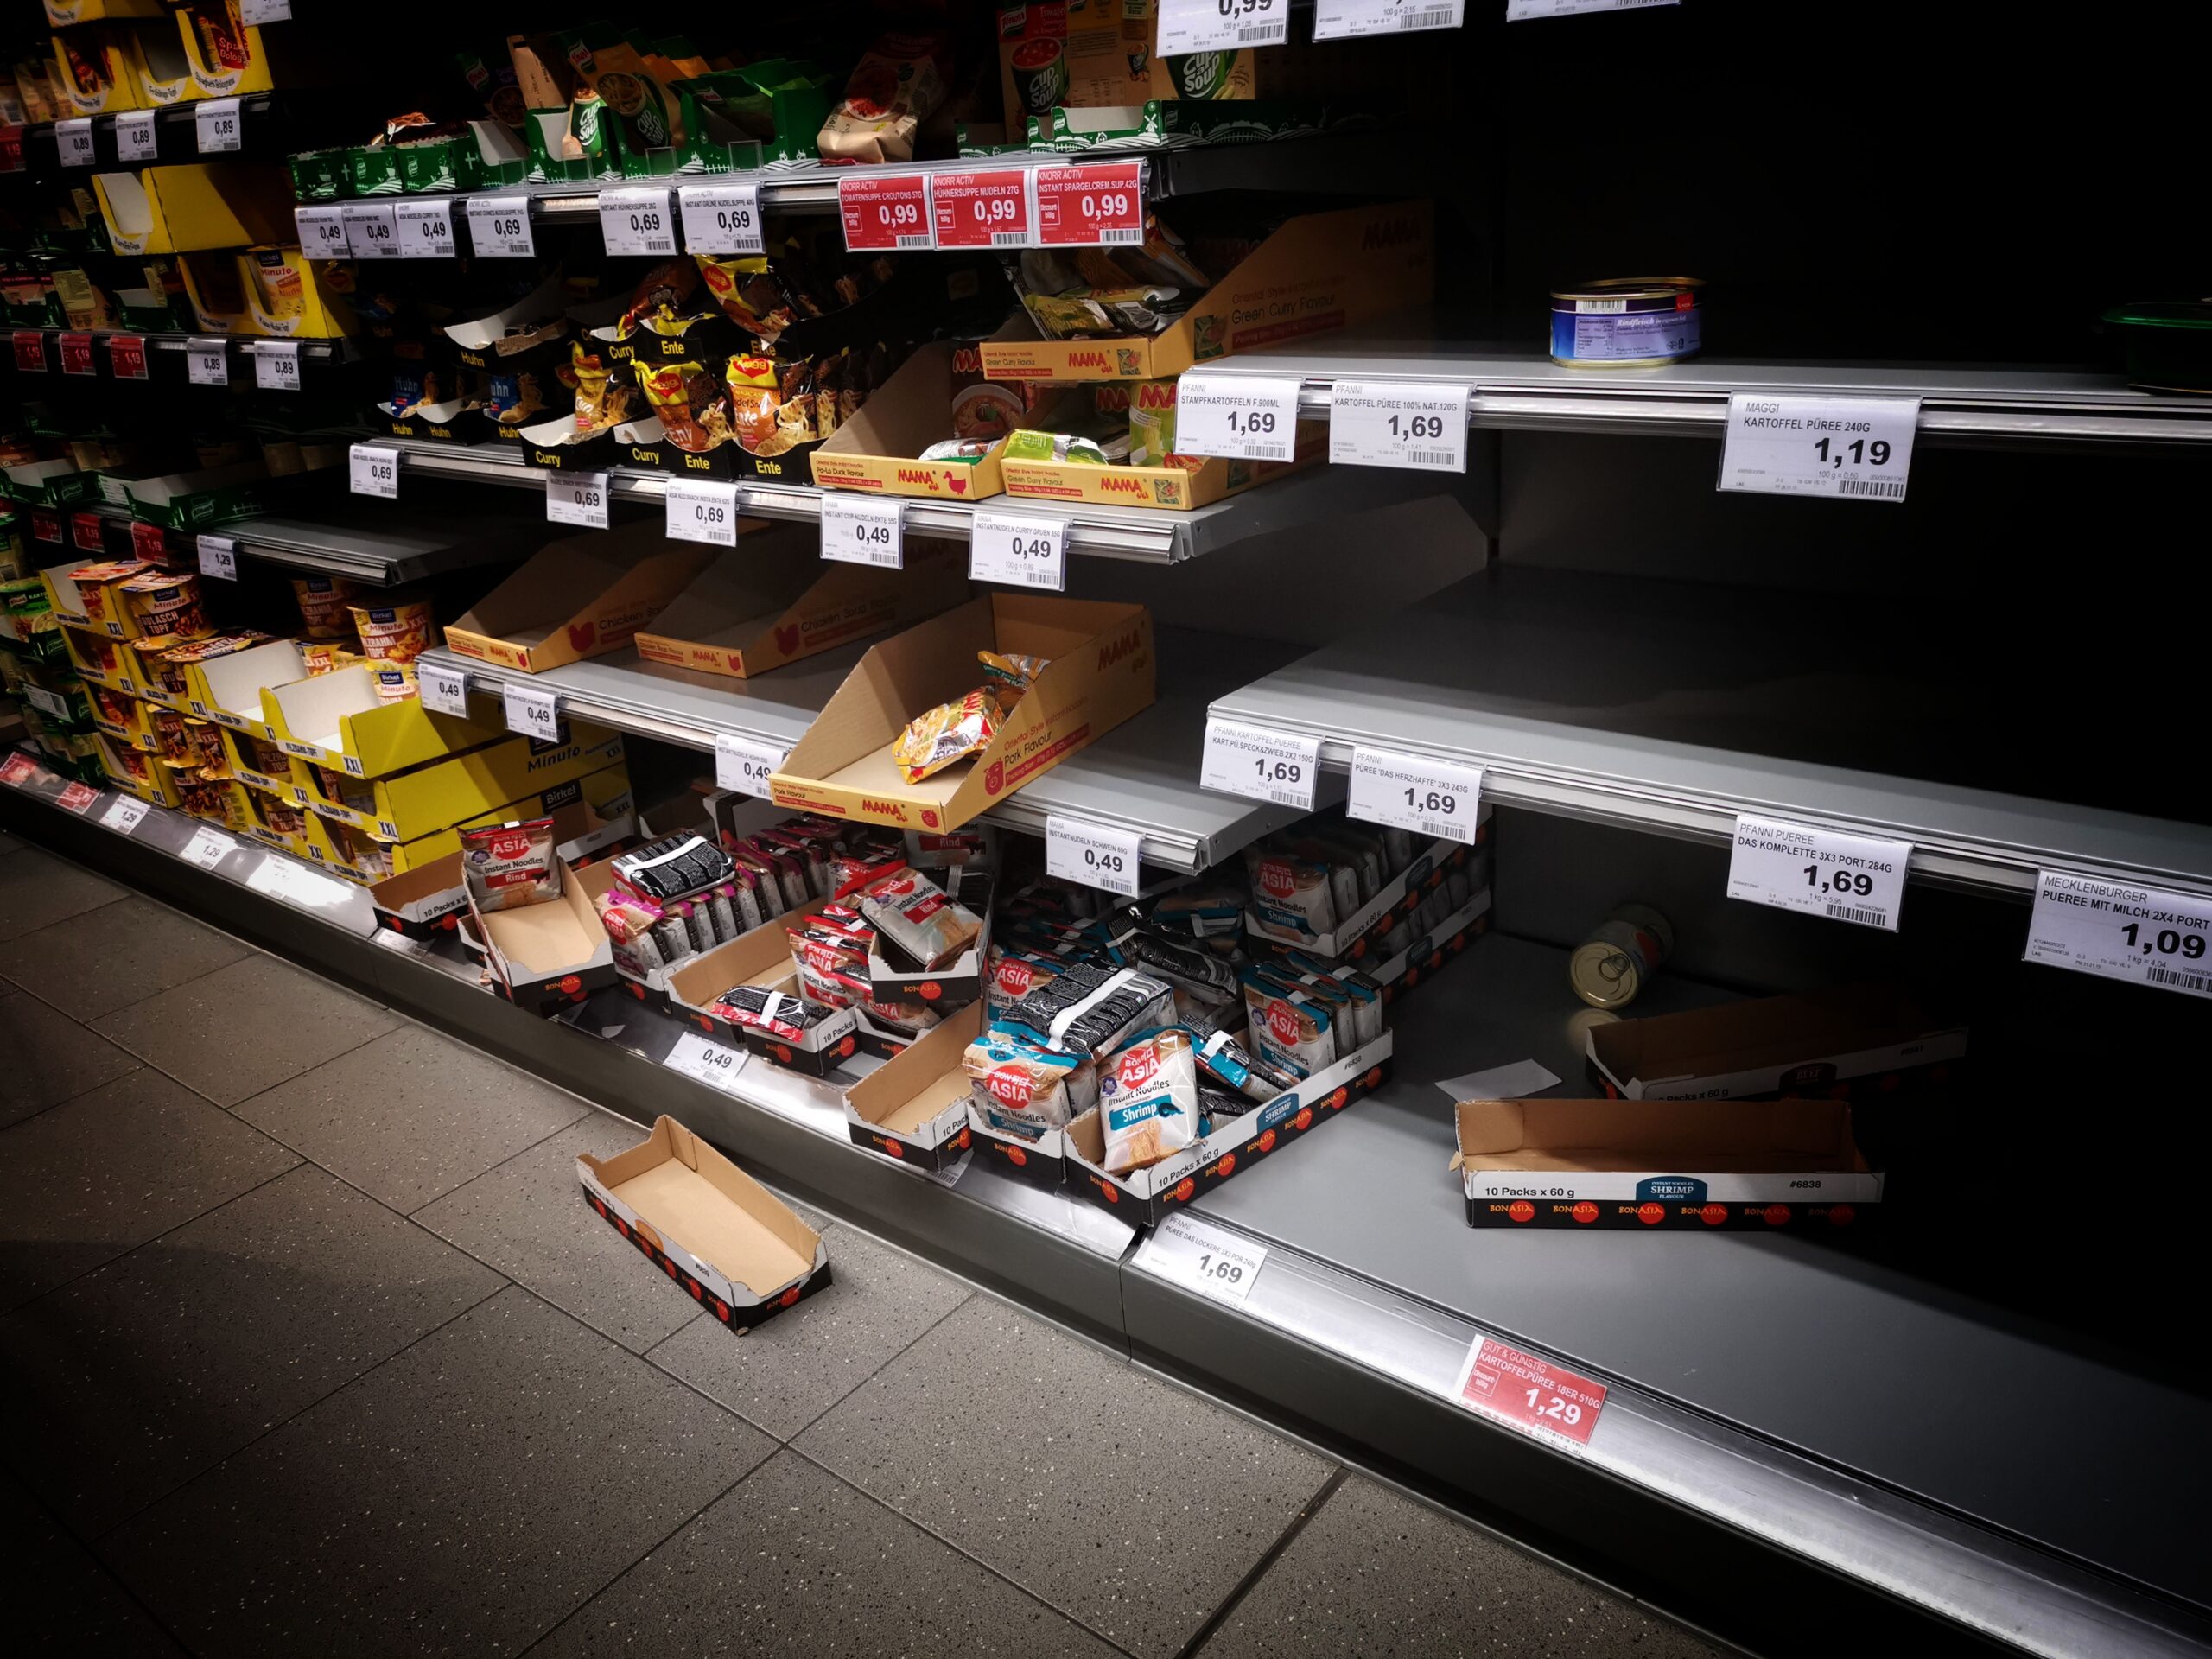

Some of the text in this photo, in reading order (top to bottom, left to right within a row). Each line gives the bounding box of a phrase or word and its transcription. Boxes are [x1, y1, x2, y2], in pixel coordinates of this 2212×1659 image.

[1218, 0, 1272, 19] 0,99
[1029, 67, 1055, 92] CUP
[1031, 75, 1059, 108] SOUP
[214, 121, 233, 136] 0,89
[132, 132, 149, 146] 0,89
[933, 176, 975, 187] KNORR ACTIV
[1038, 169, 1083, 181] KNORR ACTIV
[842, 181, 878, 191] KNORR ACTIV
[934, 186, 1020, 198] HÜHNERSUPPE NUDELN 27G
[1038, 183, 1063, 193] INSTANT
[842, 192, 881, 202] TOMATENSUPPE
[882, 191, 911, 200] CROUTONS
[879, 204, 918, 228] 0,99
[973, 199, 1016, 226] 0,99
[1082, 194, 1128, 221] 0,99
[423, 221, 446, 239] 0,49
[494, 219, 520, 238] 0,69
[631, 213, 660, 234] 0,69
[717, 211, 750, 232] 0,69
[320, 226, 340, 242] 0,49
[367, 225, 390, 241] 0,49
[1232, 308, 1265, 324] Green
[1617, 318, 1655, 327] Rindfleisch
[608, 345, 635, 361] Curry
[661, 340, 685, 355] Ente
[204, 357, 221, 372] 0,89
[461, 351, 485, 368] Huhn
[1068, 353, 1107, 367] MAMA
[276, 361, 294, 376] 0,89
[1182, 384, 1206, 392] PFANNI
[1336, 385, 1363, 394] PFANNI
[1181, 396, 1280, 408] STAMPFKARTOFFELN F.900ML
[1334, 398, 1457, 411] KARTOFFEL PÜREE 100% NAT.120G
[1745, 403, 1780, 413] MAGGI
[391, 423, 413, 436] Huhn
[1227, 411, 1275, 436] 1,69
[1388, 415, 1443, 442] 1,69
[1744, 417, 1871, 432] KARTOFFEL PÜREE 240G
[429, 426, 452, 439] Huhn
[535, 449, 561, 468] Curry
[632, 447, 660, 465] Curry
[1815, 437, 1891, 468] 1,19
[684, 454, 710, 470] Ente
[755, 460, 782, 475] Ente
[372, 465, 391, 480] 0,69
[898, 469, 933, 484] MAMA
[1027, 476, 1041, 485] Curry
[1101, 477, 1142, 493] MAMA
[575, 491, 600, 508] 0,69
[696, 505, 724, 524] 0,69
[874, 515, 887, 524] ENTE
[888, 517, 897, 525] 55G
[856, 524, 890, 545] 0,49
[976, 523, 1014, 533] INSTANTNUDELN
[1013, 537, 1051, 560] 0,49
[214, 552, 232, 567] 1,29
[439, 681, 460, 698] 0,49
[527, 707, 550, 724] 0,49
[1214, 726, 1301, 750] PFANNI KARTOFFEL PUEREE
[1004, 731, 1052, 767] Pork Flavour
[344, 757, 362, 773] XXL
[1298, 753, 1313, 763] 150G
[1357, 753, 1382, 765] PFANNI
[744, 762, 772, 779] 0,49
[1255, 758, 1301, 783] 1,69
[1356, 764, 1377, 774] PÜREE
[1438, 781, 1450, 790] 3X3
[1451, 784, 1468, 793] 243G
[862, 799, 900, 816] MAMA
[1404, 787, 1456, 815] 1,69
[120, 810, 137, 823] 1,29
[378, 821, 397, 838] XXL
[1739, 823, 1815, 846] PFANNI PUEREE
[492, 839, 531, 855] ASIA
[1049, 830, 1090, 845] INSTANTNUDELN
[1092, 840, 1116, 852] SCHWEIN
[203, 845, 221, 858] 1,29
[1738, 836, 1892, 873] DAS KOMPLETTE 3X3 PORT.284G
[484, 858, 543, 874] Instant Noodles
[1084, 849, 1122, 872] 0,49
[505, 872, 527, 882] Rind
[1260, 871, 1294, 890] ASIA
[1803, 864, 1873, 896] 1,69
[894, 886, 936, 910] Instant Noodles
[2044, 876, 2149, 904] MECKLENBURGER
[423, 901, 455, 918] 10 Packs
[2042, 890, 2211, 930] PUEREE MIT MILCH 2X4 PORT
[1268, 910, 1297, 927] Shrimp
[2121, 923, 2206, 959] 1,09
[996, 968, 1030, 987] ASIA
[823, 1021, 853, 1044] 10 Packs
[1268, 1013, 1301, 1038] ASIA
[702, 1049, 733, 1069] 0,49
[1270, 1052, 1299, 1076] Shrimp
[1281, 1046, 1309, 1065] Noodles
[1121, 1059, 1161, 1083] ASIA
[989, 1081, 1029, 1102] ASIA
[1011, 1109, 1046, 1123] Noodles
[1122, 1103, 1157, 1122] Shrimp
[1158, 1150, 1213, 1188] 10 Packs 60
[1484, 1187, 1499, 1197] 10
[1501, 1186, 1537, 1197] Packs
[1549, 1187, 1565, 1197] 60
[1567, 1189, 1575, 1199] g
[1649, 1185, 1694, 1195] SHRIMP
[1789, 1179, 1821, 1189] #6838
[1169, 1217, 1191, 1230] PFANNI
[1166, 1225, 1183, 1238] PÜREE
[1184, 1233, 1195, 1243] DAS
[1195, 1238, 1221, 1253] LOCKERE
[1200, 1255, 1243, 1283] 1,69
[1484, 1341, 1500, 1354] GUT
[1509, 1351, 1548, 1374] GÜNSTIG
[1479, 1352, 1600, 1408] KARTOFFELPÜREE 18ER 510G
[1526, 1388, 1582, 1426] 1,29
